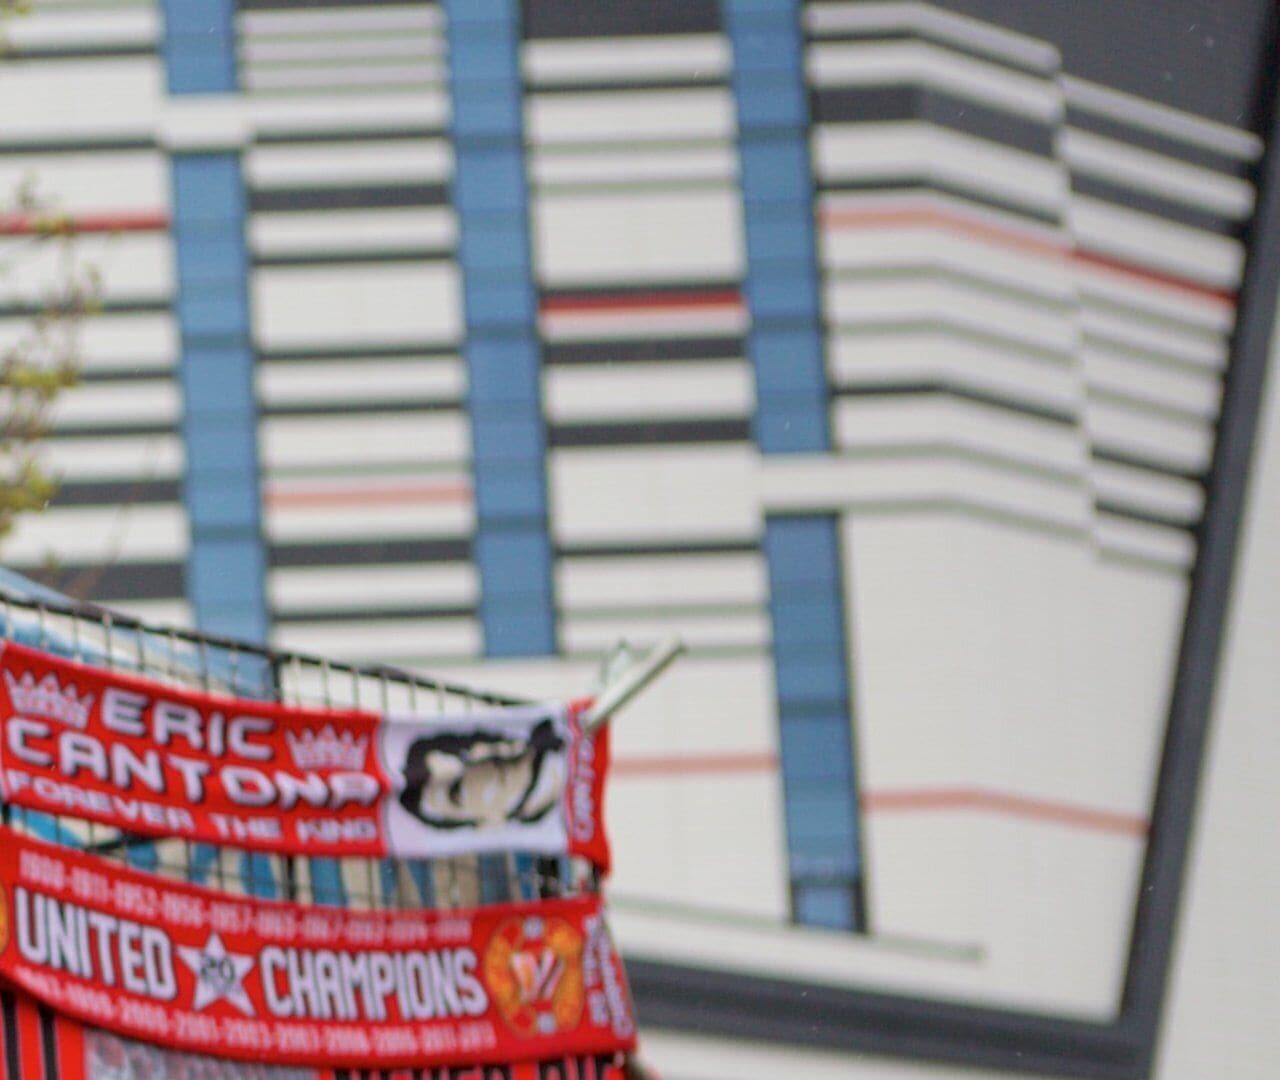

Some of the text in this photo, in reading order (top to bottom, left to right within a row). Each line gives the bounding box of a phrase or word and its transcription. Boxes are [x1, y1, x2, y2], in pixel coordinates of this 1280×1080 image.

[5, 714, 381, 812] CANTONA
[100, 684, 275, 762] ERIC
[7, 769, 378, 843] FOREVER THE KING
[14, 885, 178, 1000] UNITED
[200, 953, 236, 981] 20
[259, 944, 490, 1022] CHAMPIONS
